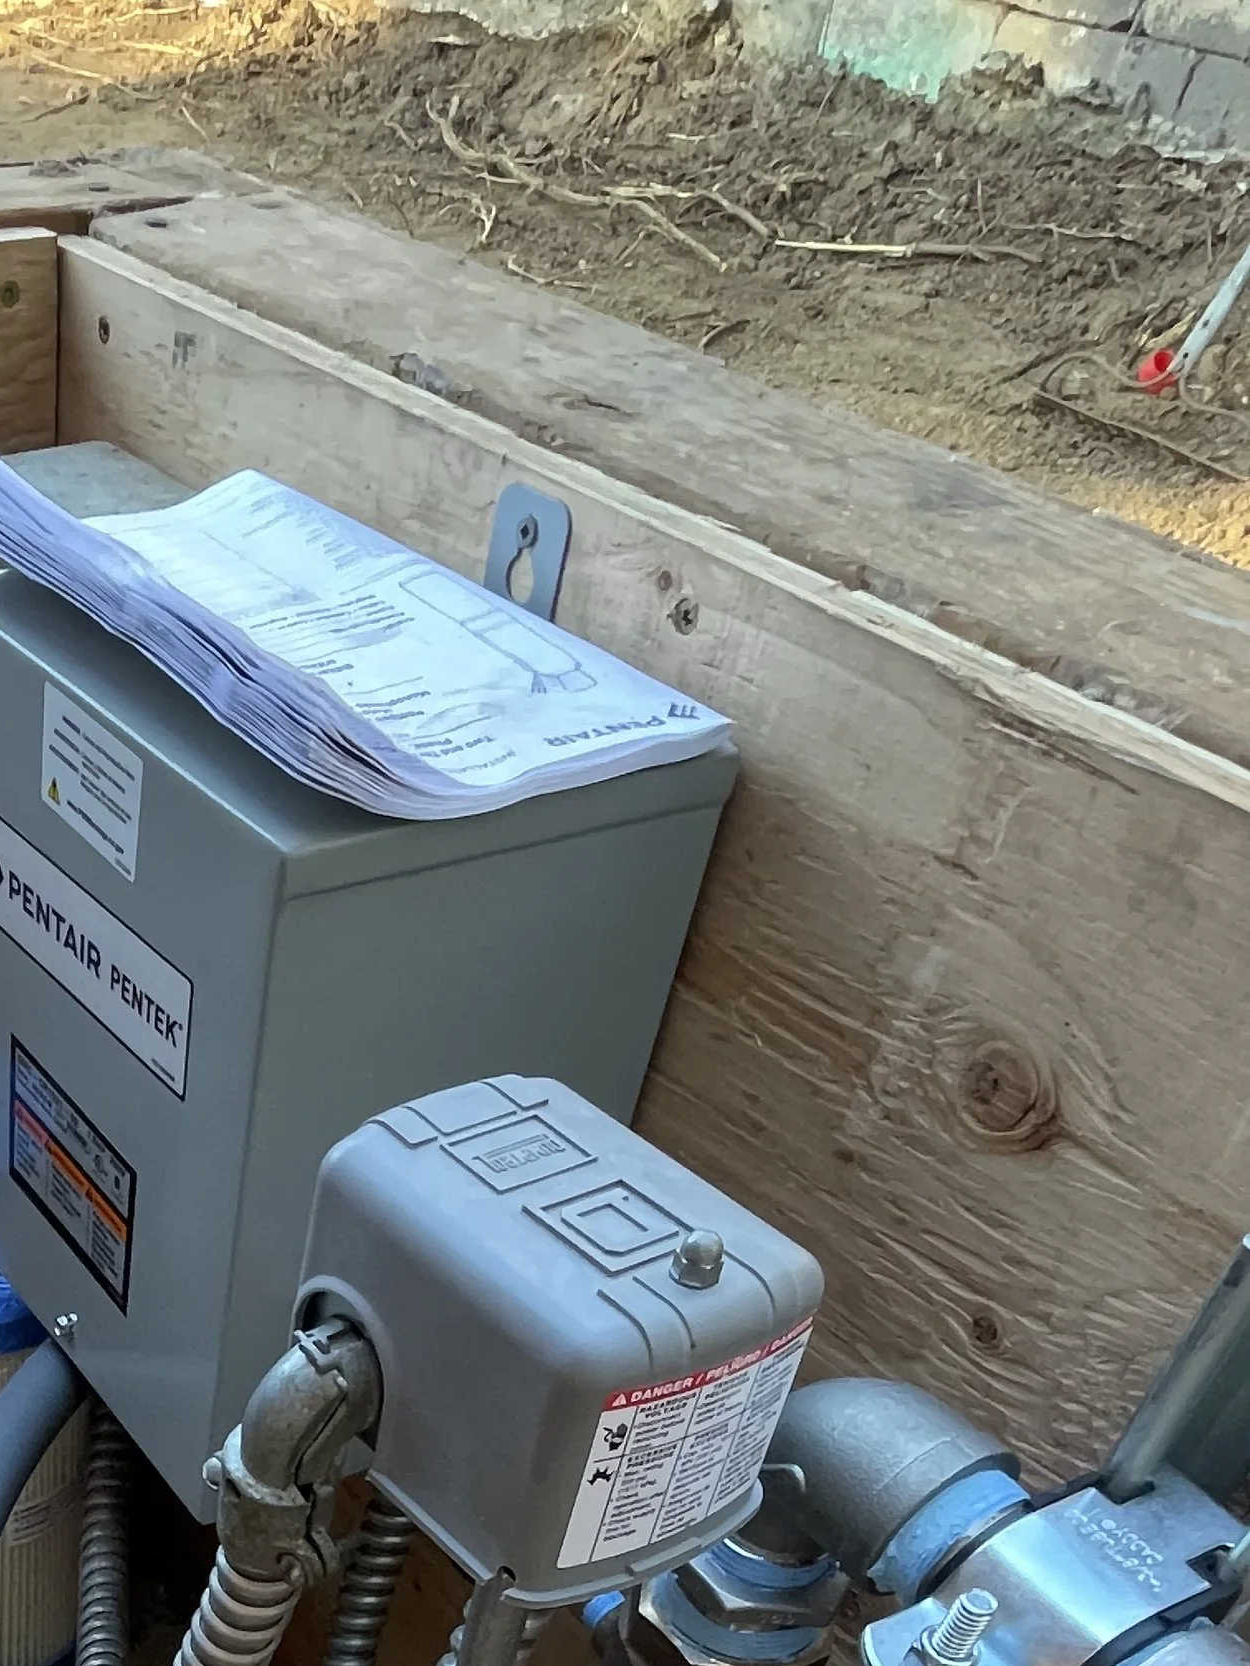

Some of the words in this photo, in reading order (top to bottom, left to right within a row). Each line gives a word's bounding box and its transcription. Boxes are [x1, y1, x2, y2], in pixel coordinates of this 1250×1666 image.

[543, 716, 667, 747] PENTAIR
[9, 870, 101, 979] PENTAIR
[110, 964, 178, 1048] PENTEK
[630, 1377, 694, 1402] DANGER
